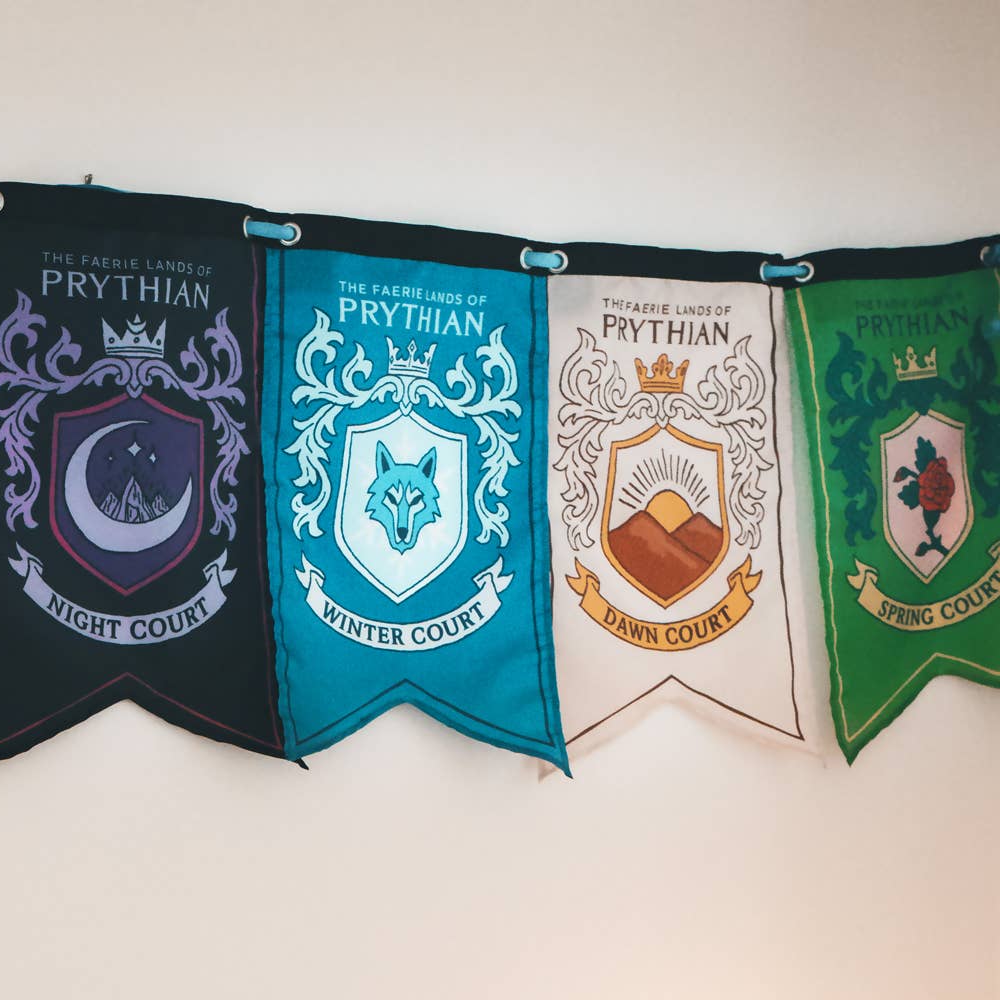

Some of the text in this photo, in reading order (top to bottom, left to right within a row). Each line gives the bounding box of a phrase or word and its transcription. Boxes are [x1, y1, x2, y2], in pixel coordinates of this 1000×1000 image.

[42, 251, 212, 277] THE FAERIE LANDS OF
[41, 269, 210, 311] PRYTHIAN
[339, 280, 487, 306] THE FAERIE LANDS OF
[338, 297, 484, 337] PRYTHIAN
[602, 298, 732, 316] THE FAERIE LANDS OF
[856, 305, 968, 338] PRYTHIAN
[602, 313, 729, 346] PRYTHIAN
[47, 592, 210, 640] NIGHT COURT
[322, 600, 486, 645] WINTER COURT
[603, 604, 732, 645] DAWN COURT
[878, 600, 934, 626] SPRING
